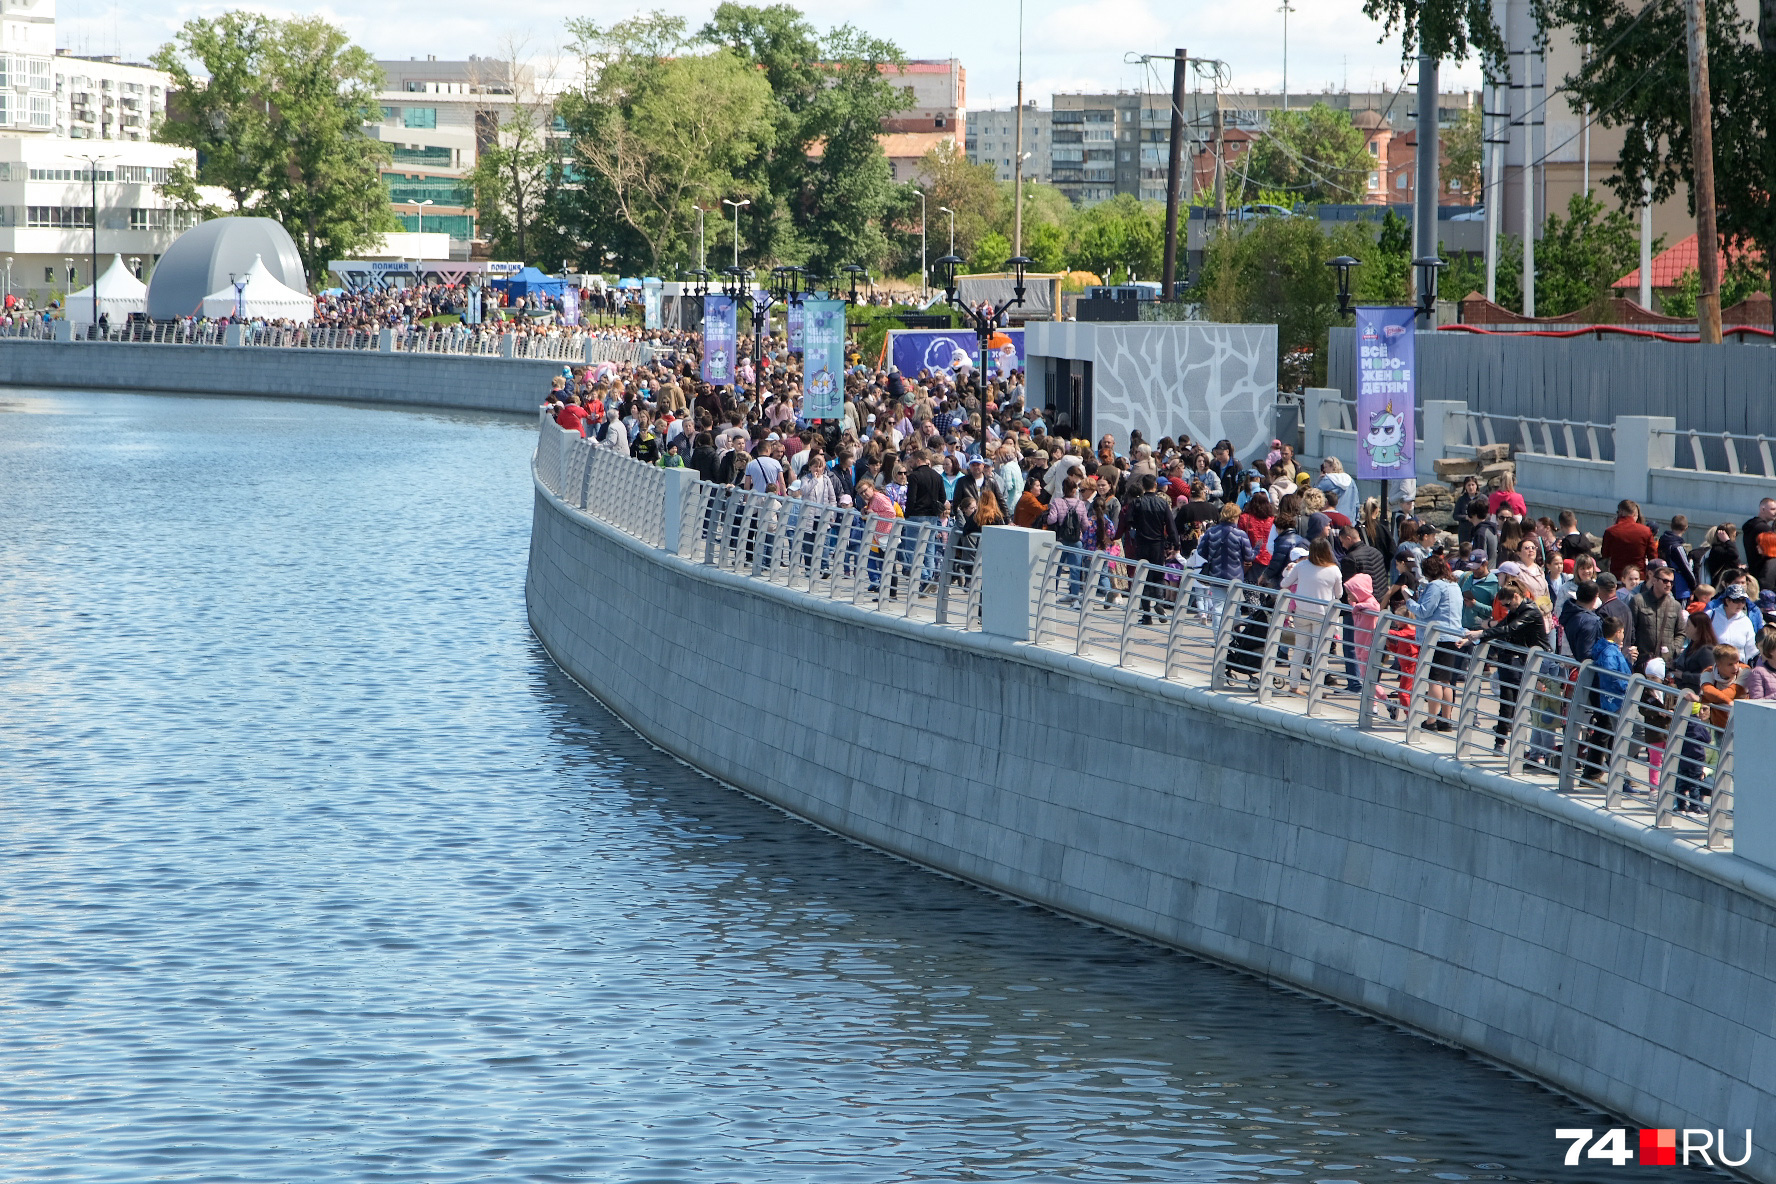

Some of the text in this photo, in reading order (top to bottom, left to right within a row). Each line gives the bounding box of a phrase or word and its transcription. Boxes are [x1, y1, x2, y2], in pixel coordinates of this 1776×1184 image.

[372, 262, 409, 271] ПОЛИЦИЯ
[1360, 343, 1388, 358] ВСЁ
[1360, 357, 1406, 370] МОРО-
[1361, 369, 1411, 382] ЖЕНОЕ
[1361, 382, 1408, 395] ДЕТЯМ
